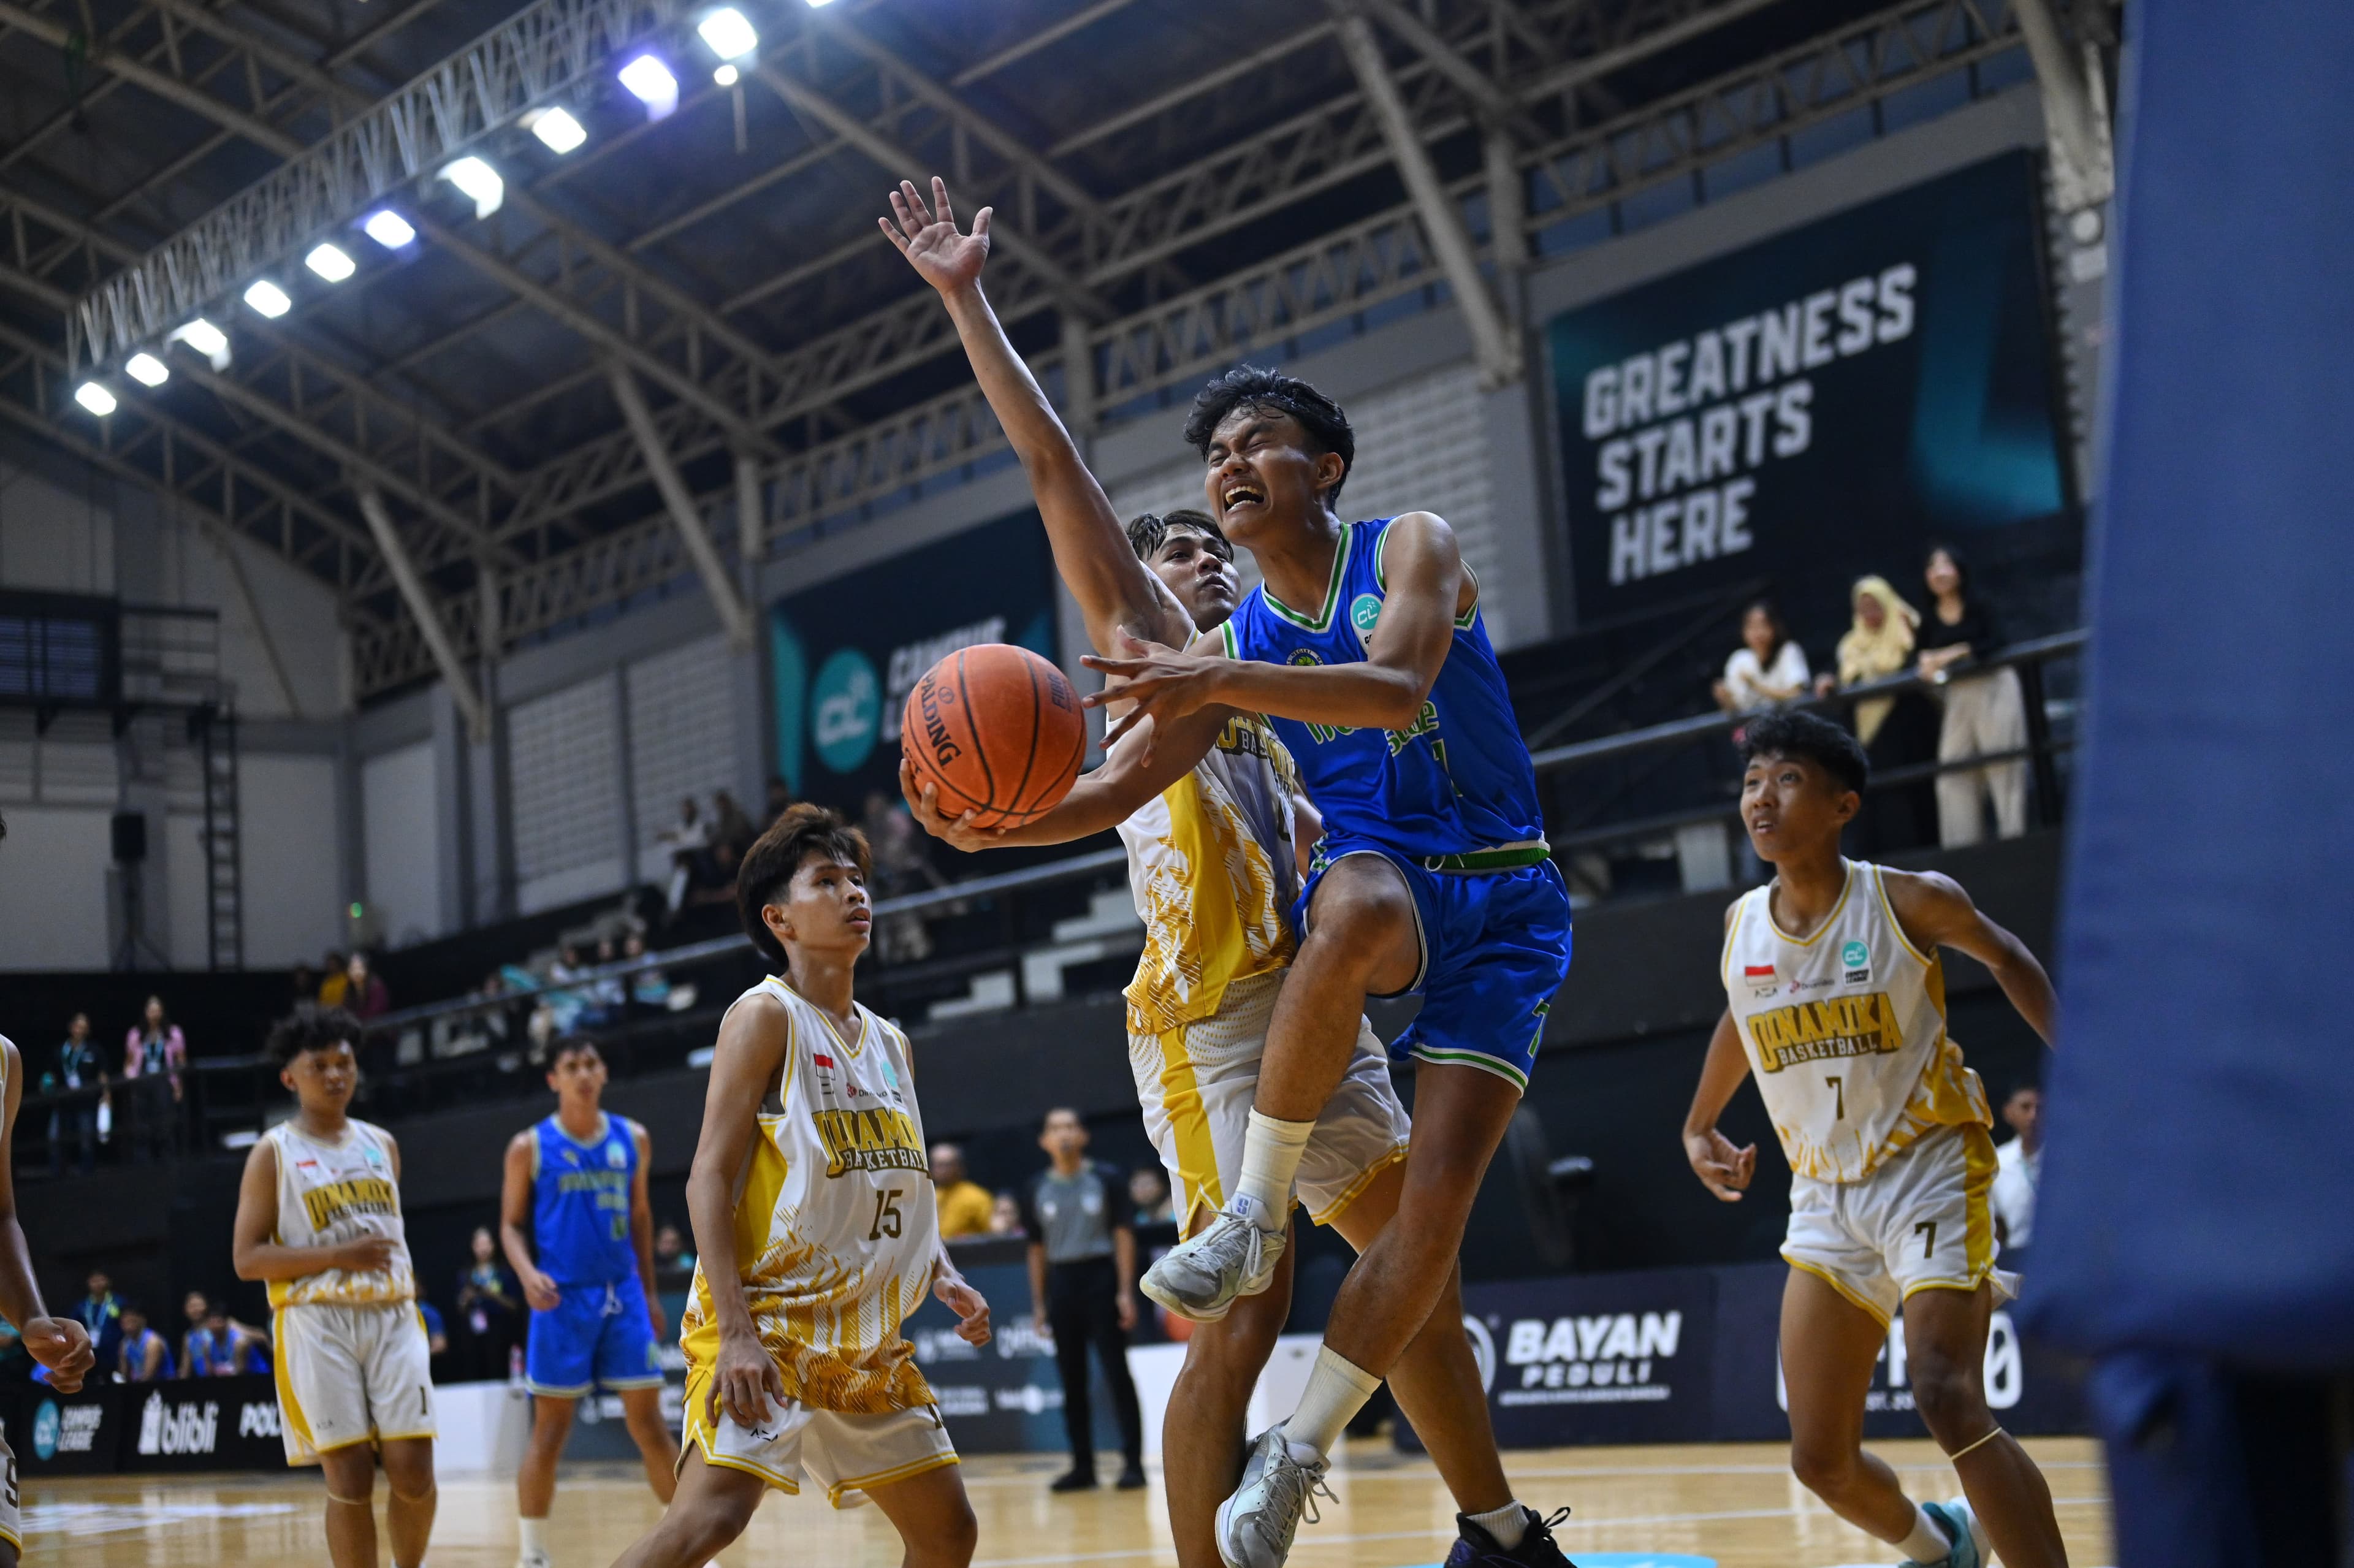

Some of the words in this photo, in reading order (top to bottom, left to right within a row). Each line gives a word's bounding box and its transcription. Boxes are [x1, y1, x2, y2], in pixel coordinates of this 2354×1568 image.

[1583, 262, 1918, 440] GREATNESS
[1596, 378, 1813, 511] STARTS
[1609, 477, 1756, 586] HERE
[921, 671, 962, 767] PALDING
[1746, 992, 1903, 1073] DINAMIKA
[1778, 1034, 1877, 1065] BASKETBALL
[1825, 1076, 1845, 1121] 7
[869, 1190, 903, 1241] 15
[1914, 1222, 1937, 1258] 7
[1506, 1311, 1683, 1365] BAYAN
[1521, 1359, 1651, 1388] PEDULI
[161, 1401, 219, 1455] blibli
[239, 1402, 284, 1438] POL
